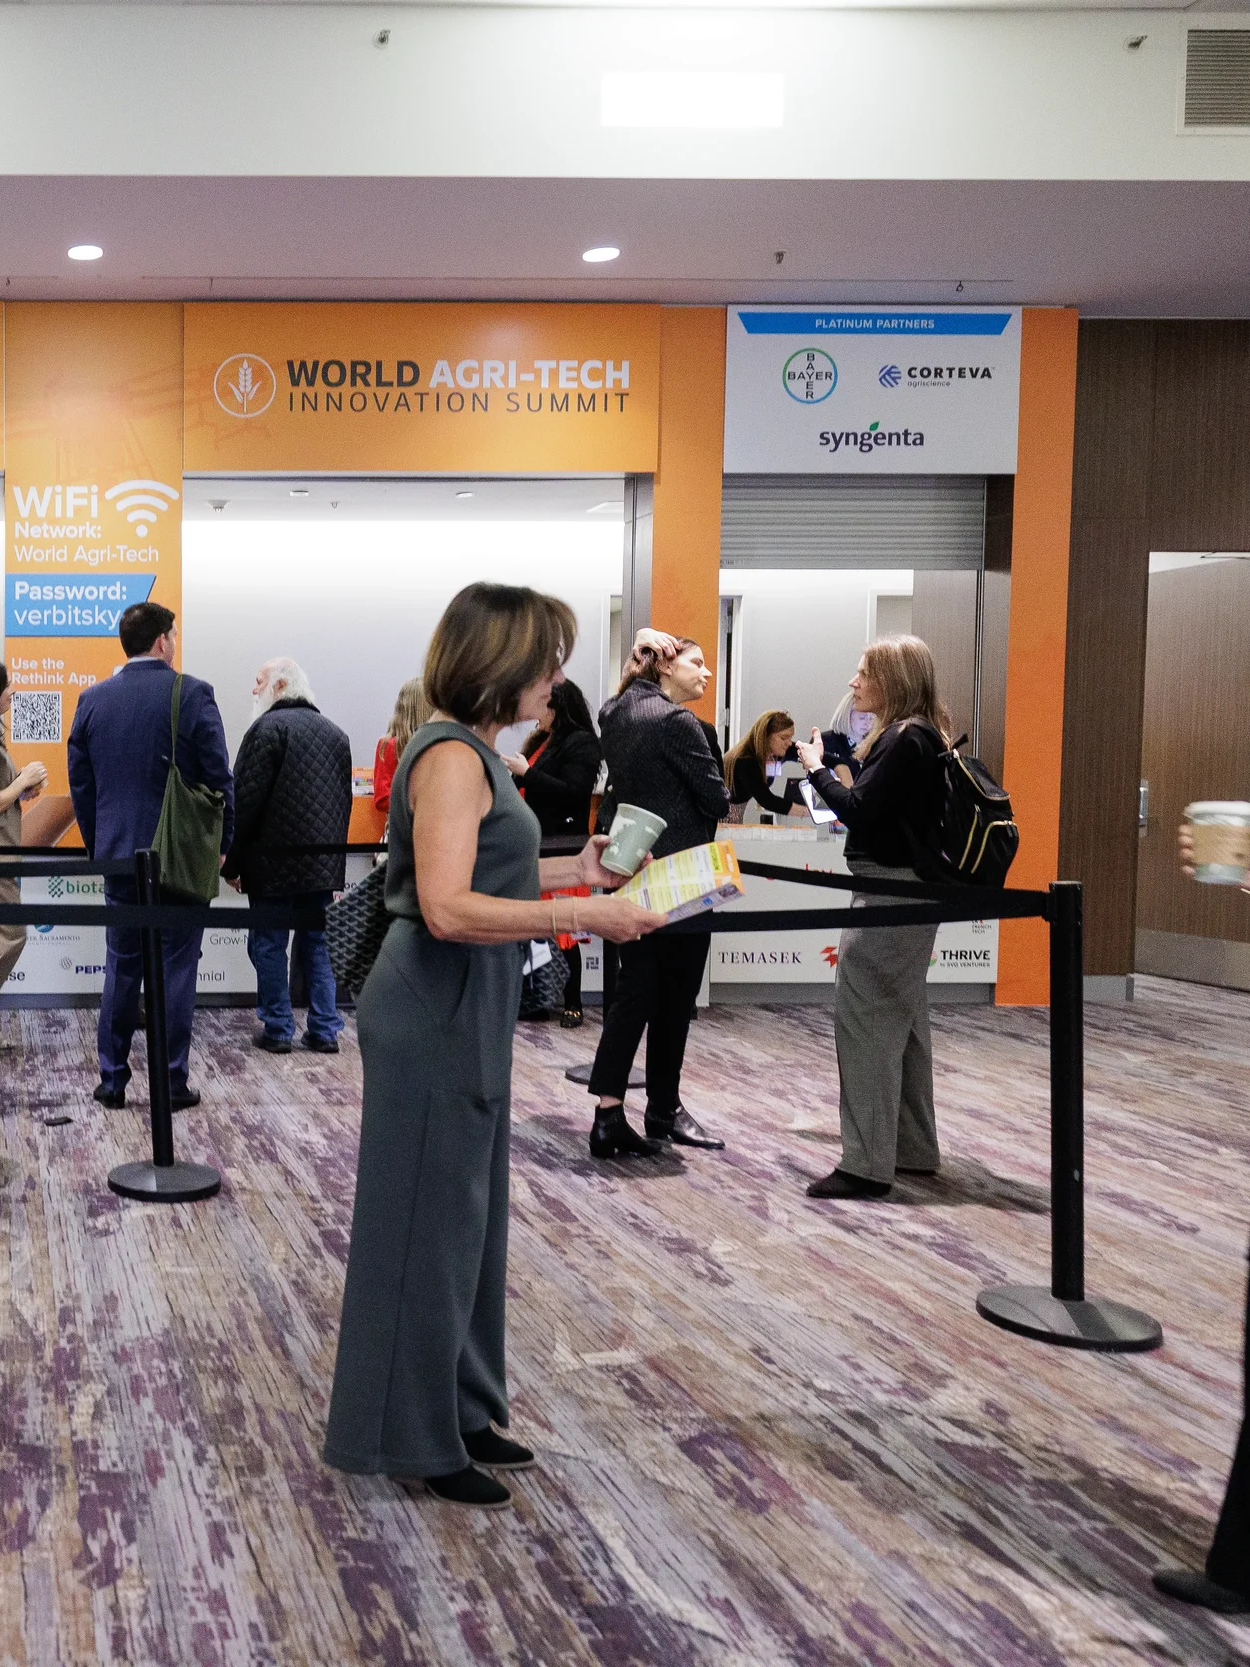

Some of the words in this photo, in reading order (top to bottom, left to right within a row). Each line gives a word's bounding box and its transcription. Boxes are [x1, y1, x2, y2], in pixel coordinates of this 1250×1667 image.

[815, 318, 873, 329] PLATINUM
[876, 318, 935, 329] PARTNERS
[286, 359, 420, 388] WORLD
[429, 359, 630, 389] AGRI-TECH
[787, 371, 833, 381] BAYER
[907, 366, 992, 379] CORTEVA
[907, 380, 951, 388] agriscience
[288, 391, 489, 413] INNOVATION
[506, 391, 630, 413] SUMMIT
[819, 428, 925, 453] syngenta
[13, 484, 98, 519] WiFi
[14, 521, 102, 539] Network:
[14, 545, 68, 563] World
[73, 545, 159, 566] Agri-Tech
[14, 581, 127, 601] Password:
[11, 658, 39, 670] Use
[41, 657, 65, 670] the
[12, 672, 64, 685] Rethink
[68, 672, 97, 687] App
[718, 951, 802, 964] TEMASEK
[940, 950, 991, 961] THRIVE
